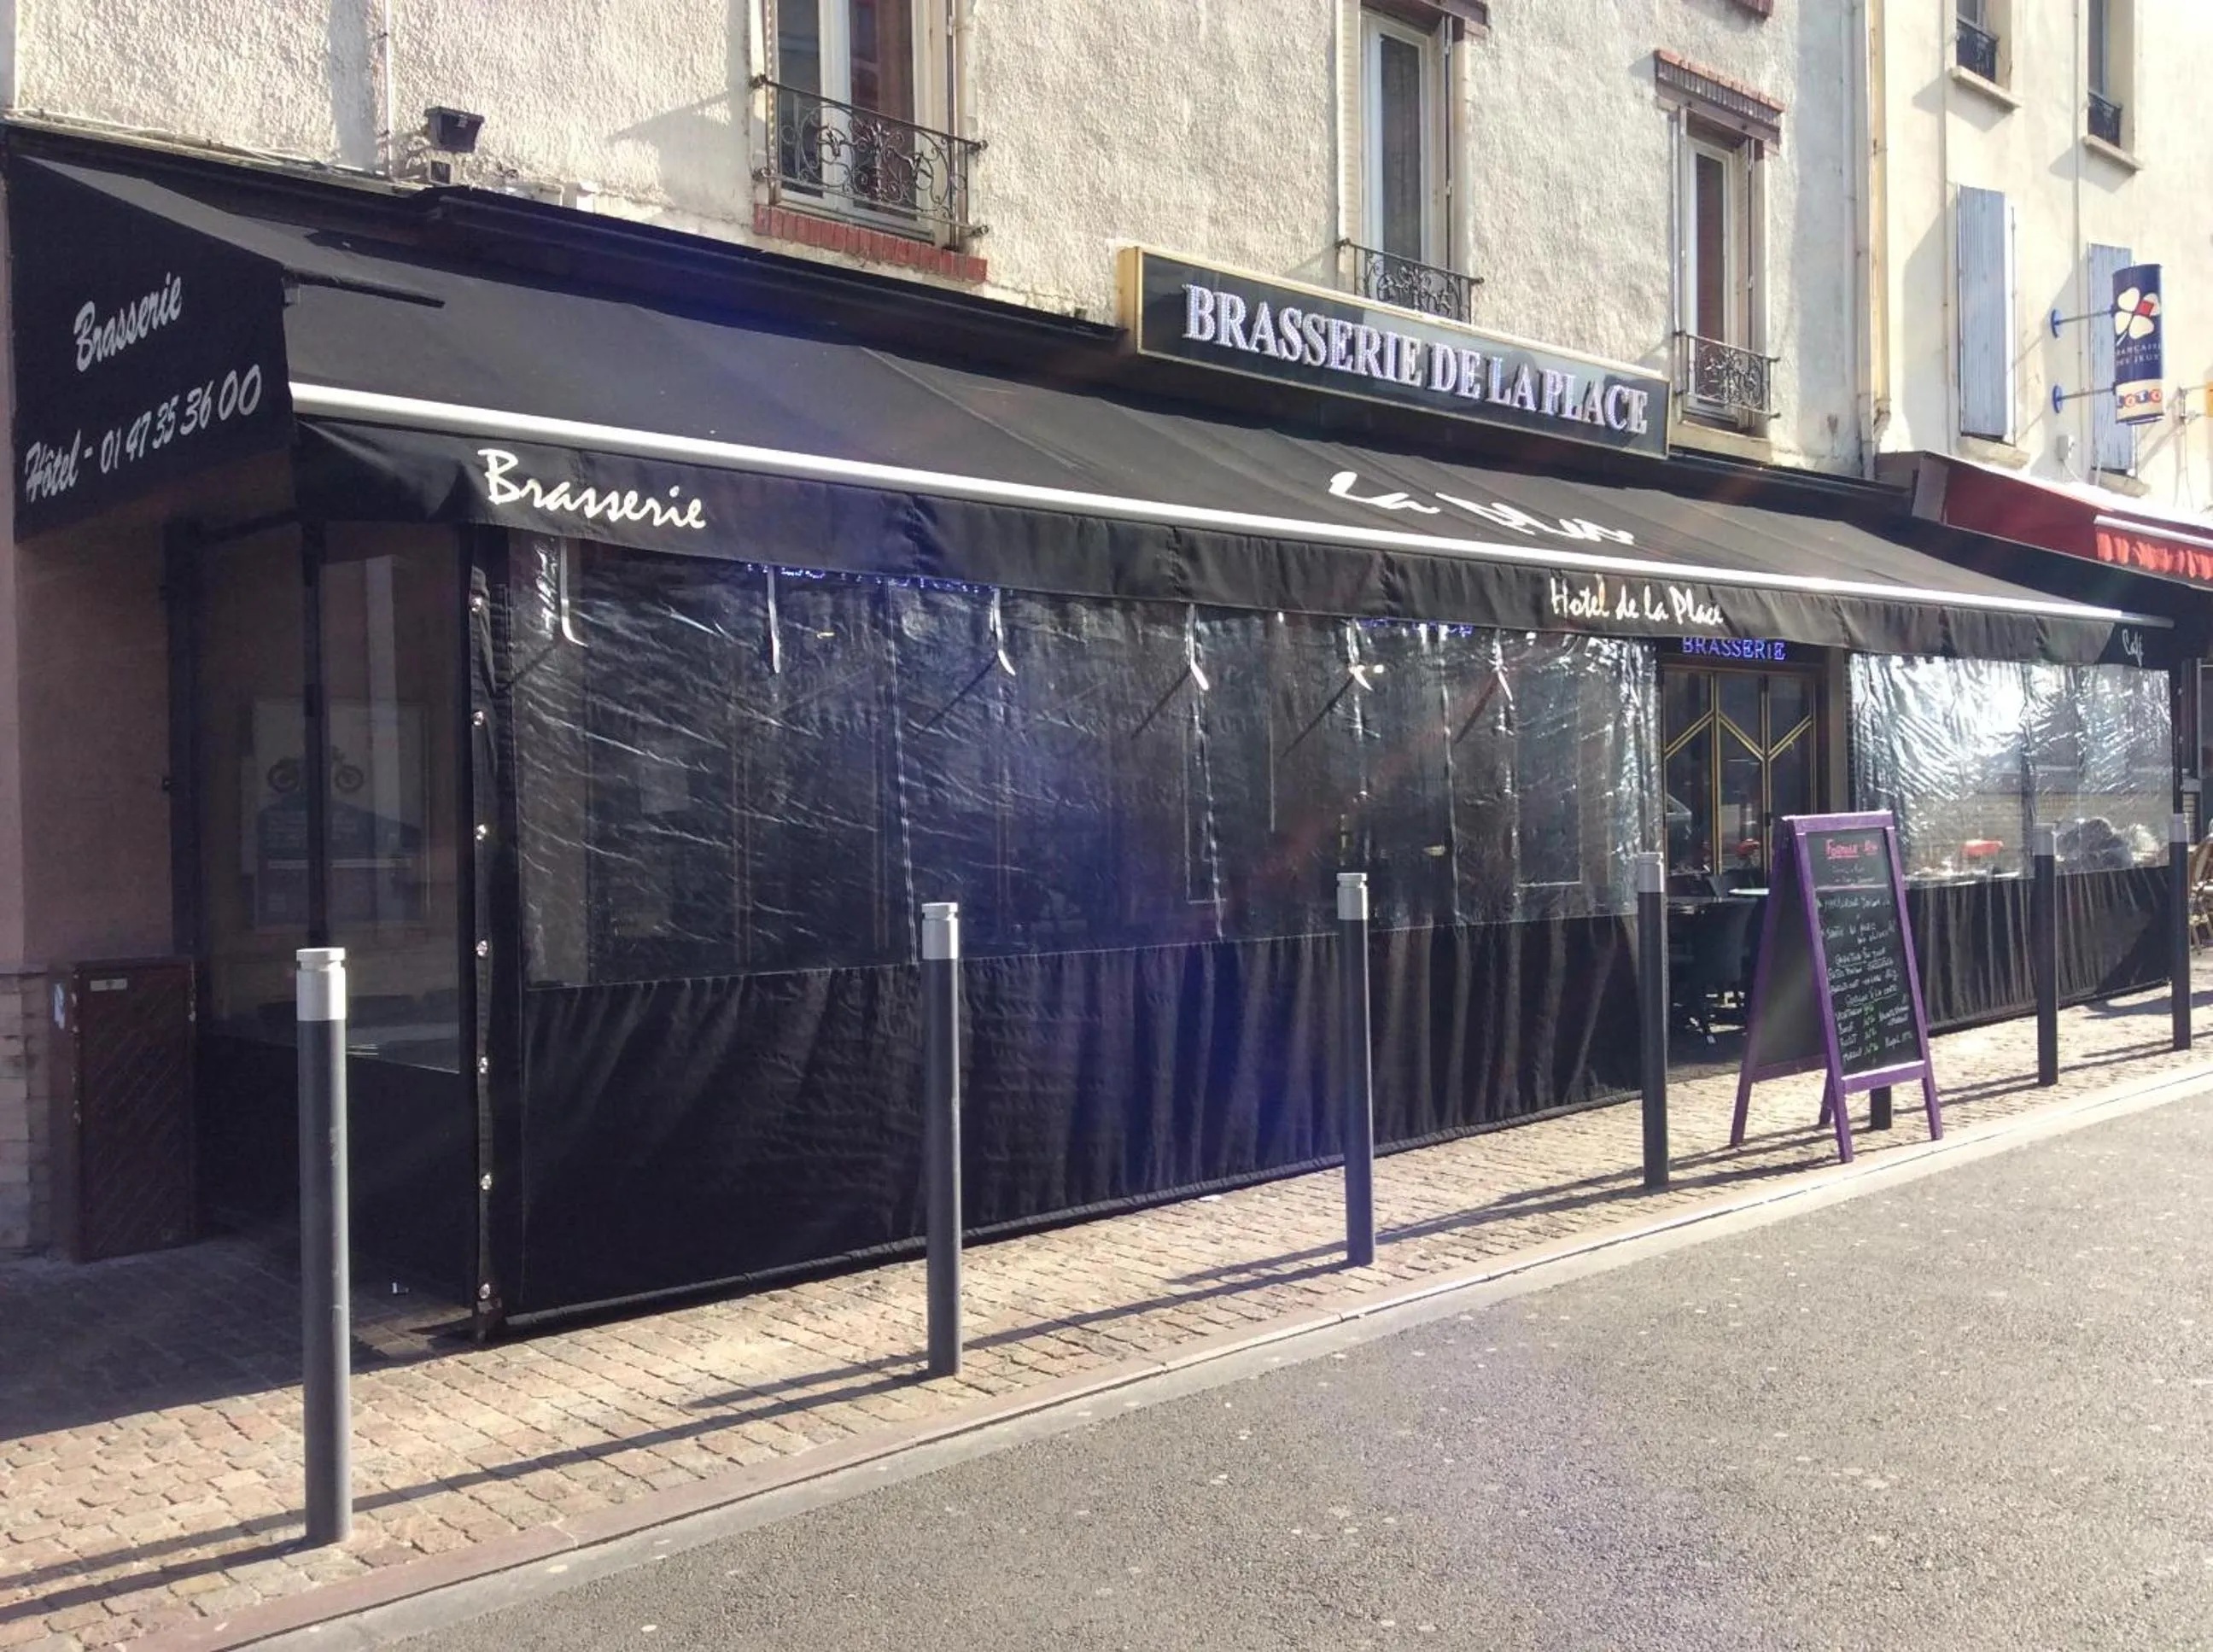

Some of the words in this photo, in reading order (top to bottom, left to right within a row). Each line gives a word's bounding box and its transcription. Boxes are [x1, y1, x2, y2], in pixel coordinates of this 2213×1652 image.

[73, 271, 183, 372] Brasserie
[1181, 283, 1422, 388] BRASSERIE
[1425, 341, 1480, 400] DE
[1485, 355, 1537, 412] LA
[1537, 368, 1649, 434] PLACE
[25, 429, 81, 503] Hôtel
[100, 427, 122, 475] 01
[477, 447, 707, 529] Brasserie
[1550, 573, 1610, 620] Hotel
[1615, 584, 1640, 622] de
[1643, 584, 1668, 623] la
[1668, 585, 1725, 627] Place
[1681, 636, 1787, 662] BRASSERIE
